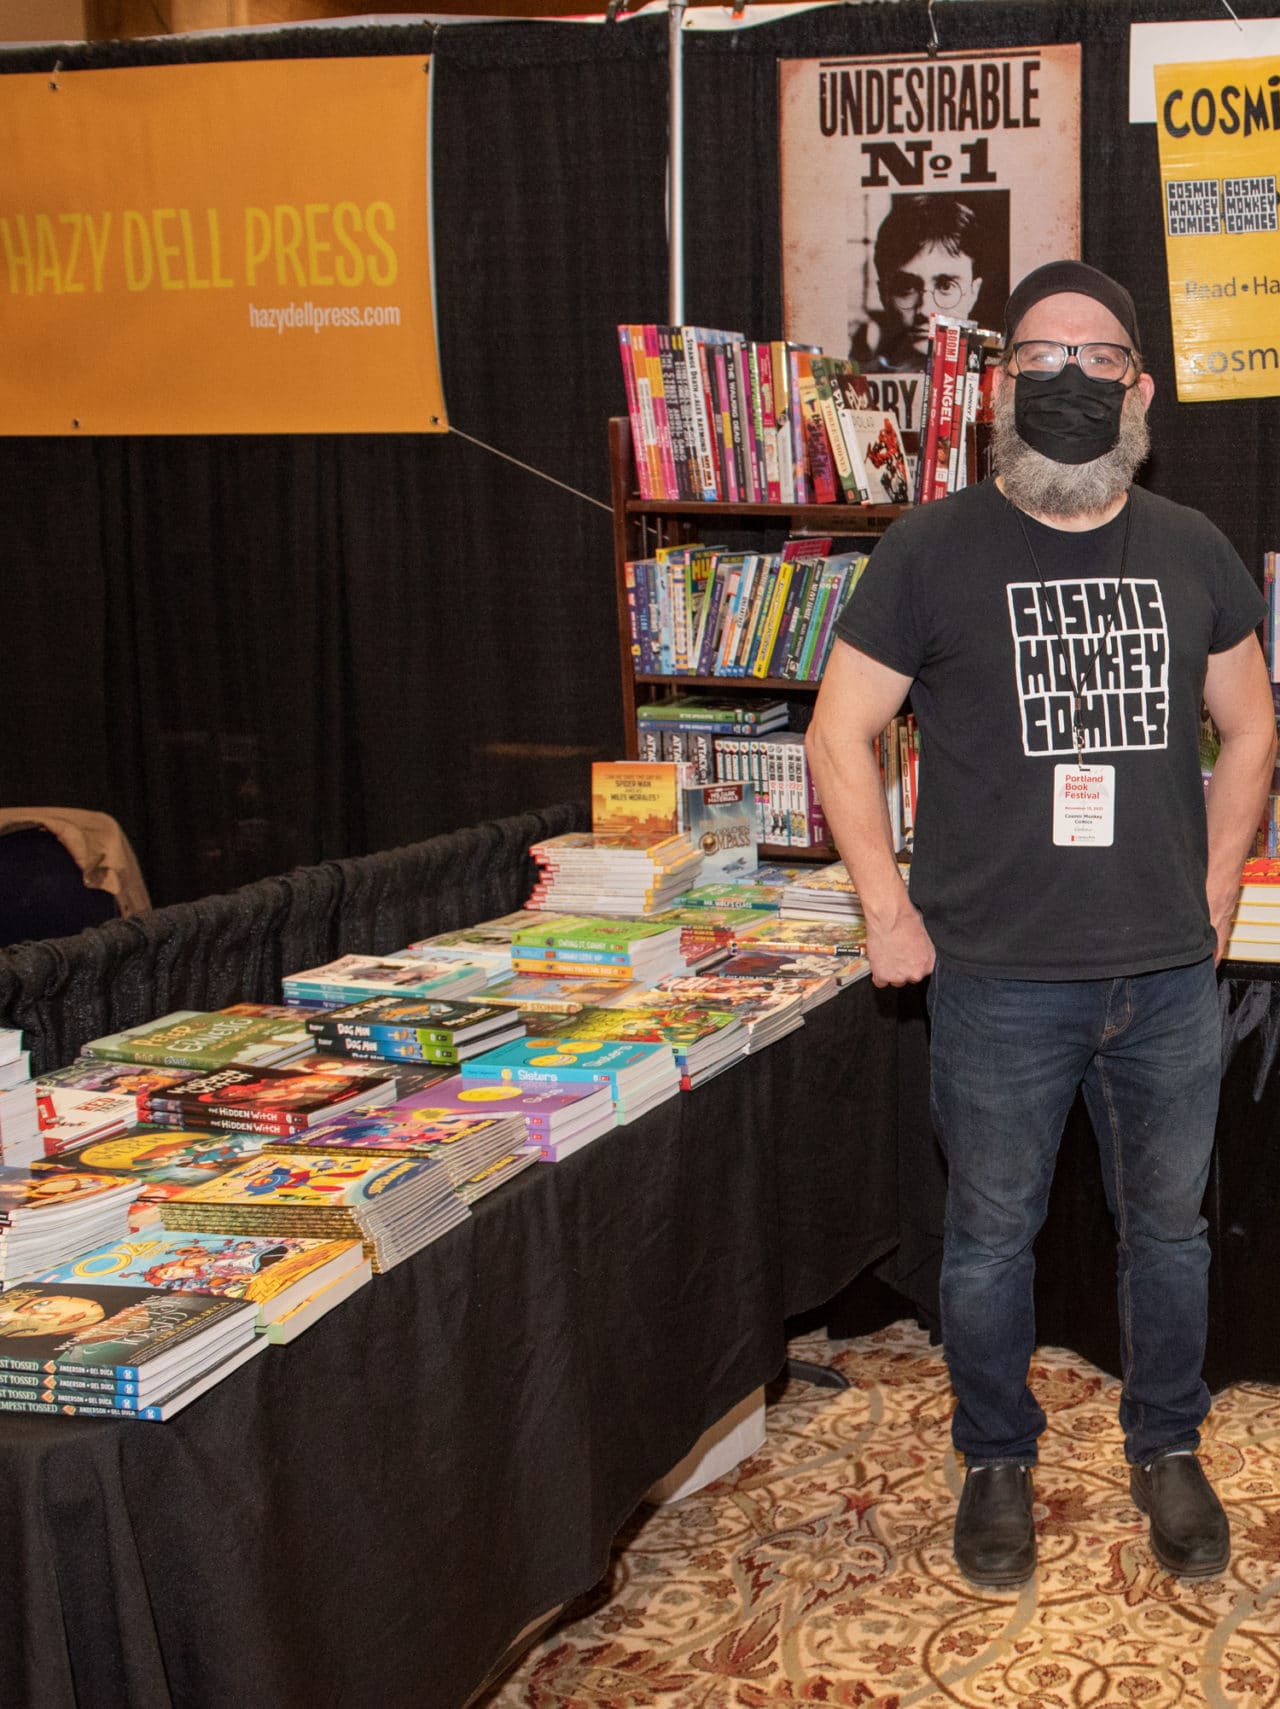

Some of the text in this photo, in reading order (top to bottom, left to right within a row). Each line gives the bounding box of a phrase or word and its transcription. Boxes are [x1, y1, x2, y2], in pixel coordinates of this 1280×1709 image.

[819, 61, 1041, 137] UNDESIRABLE
[1168, 181, 1218, 199] COSMIC
[1225, 178, 1275, 197] COSMIC
[1169, 199, 1218, 217] MONKEY
[1226, 196, 1275, 214] MONKEY
[1170, 217, 1219, 234] COMICS
[1228, 213, 1276, 231] COMICS
[2, 201, 398, 296] HAZY DELL PRESS
[1185, 279, 1237, 301] Read
[248, 301, 401, 334] hazydellpress.com
[945, 328, 959, 362] BOOM!
[727, 362, 741, 444] THE WALKING DEAD
[940, 373, 954, 425] ANGEL
[1006, 578, 1166, 641] COSMIC
[1015, 632, 1170, 699] MONKEY
[1021, 690, 1168, 756] COMICS
[1065, 774, 1104, 783] Portland
[1065, 783, 1088, 791] Book
[1065, 791, 1100, 800] Festival
[337, 1023, 370, 1037] DOG MAN
[345, 1038, 377, 1052] DOG MAN
[517, 1069, 558, 1083] Sisters
[11, 1360, 39, 1371] TOSSED
[59, 1365, 86, 1374] ANDERSON
[10, 1375, 39, 1386] TOSSED
[59, 1379, 86, 1388] ANDERSON
[9, 1390, 37, 1401] TOSSED
[58, 1394, 84, 1402] ANDERSON
[30, 1403, 58, 1413] TOSSED
